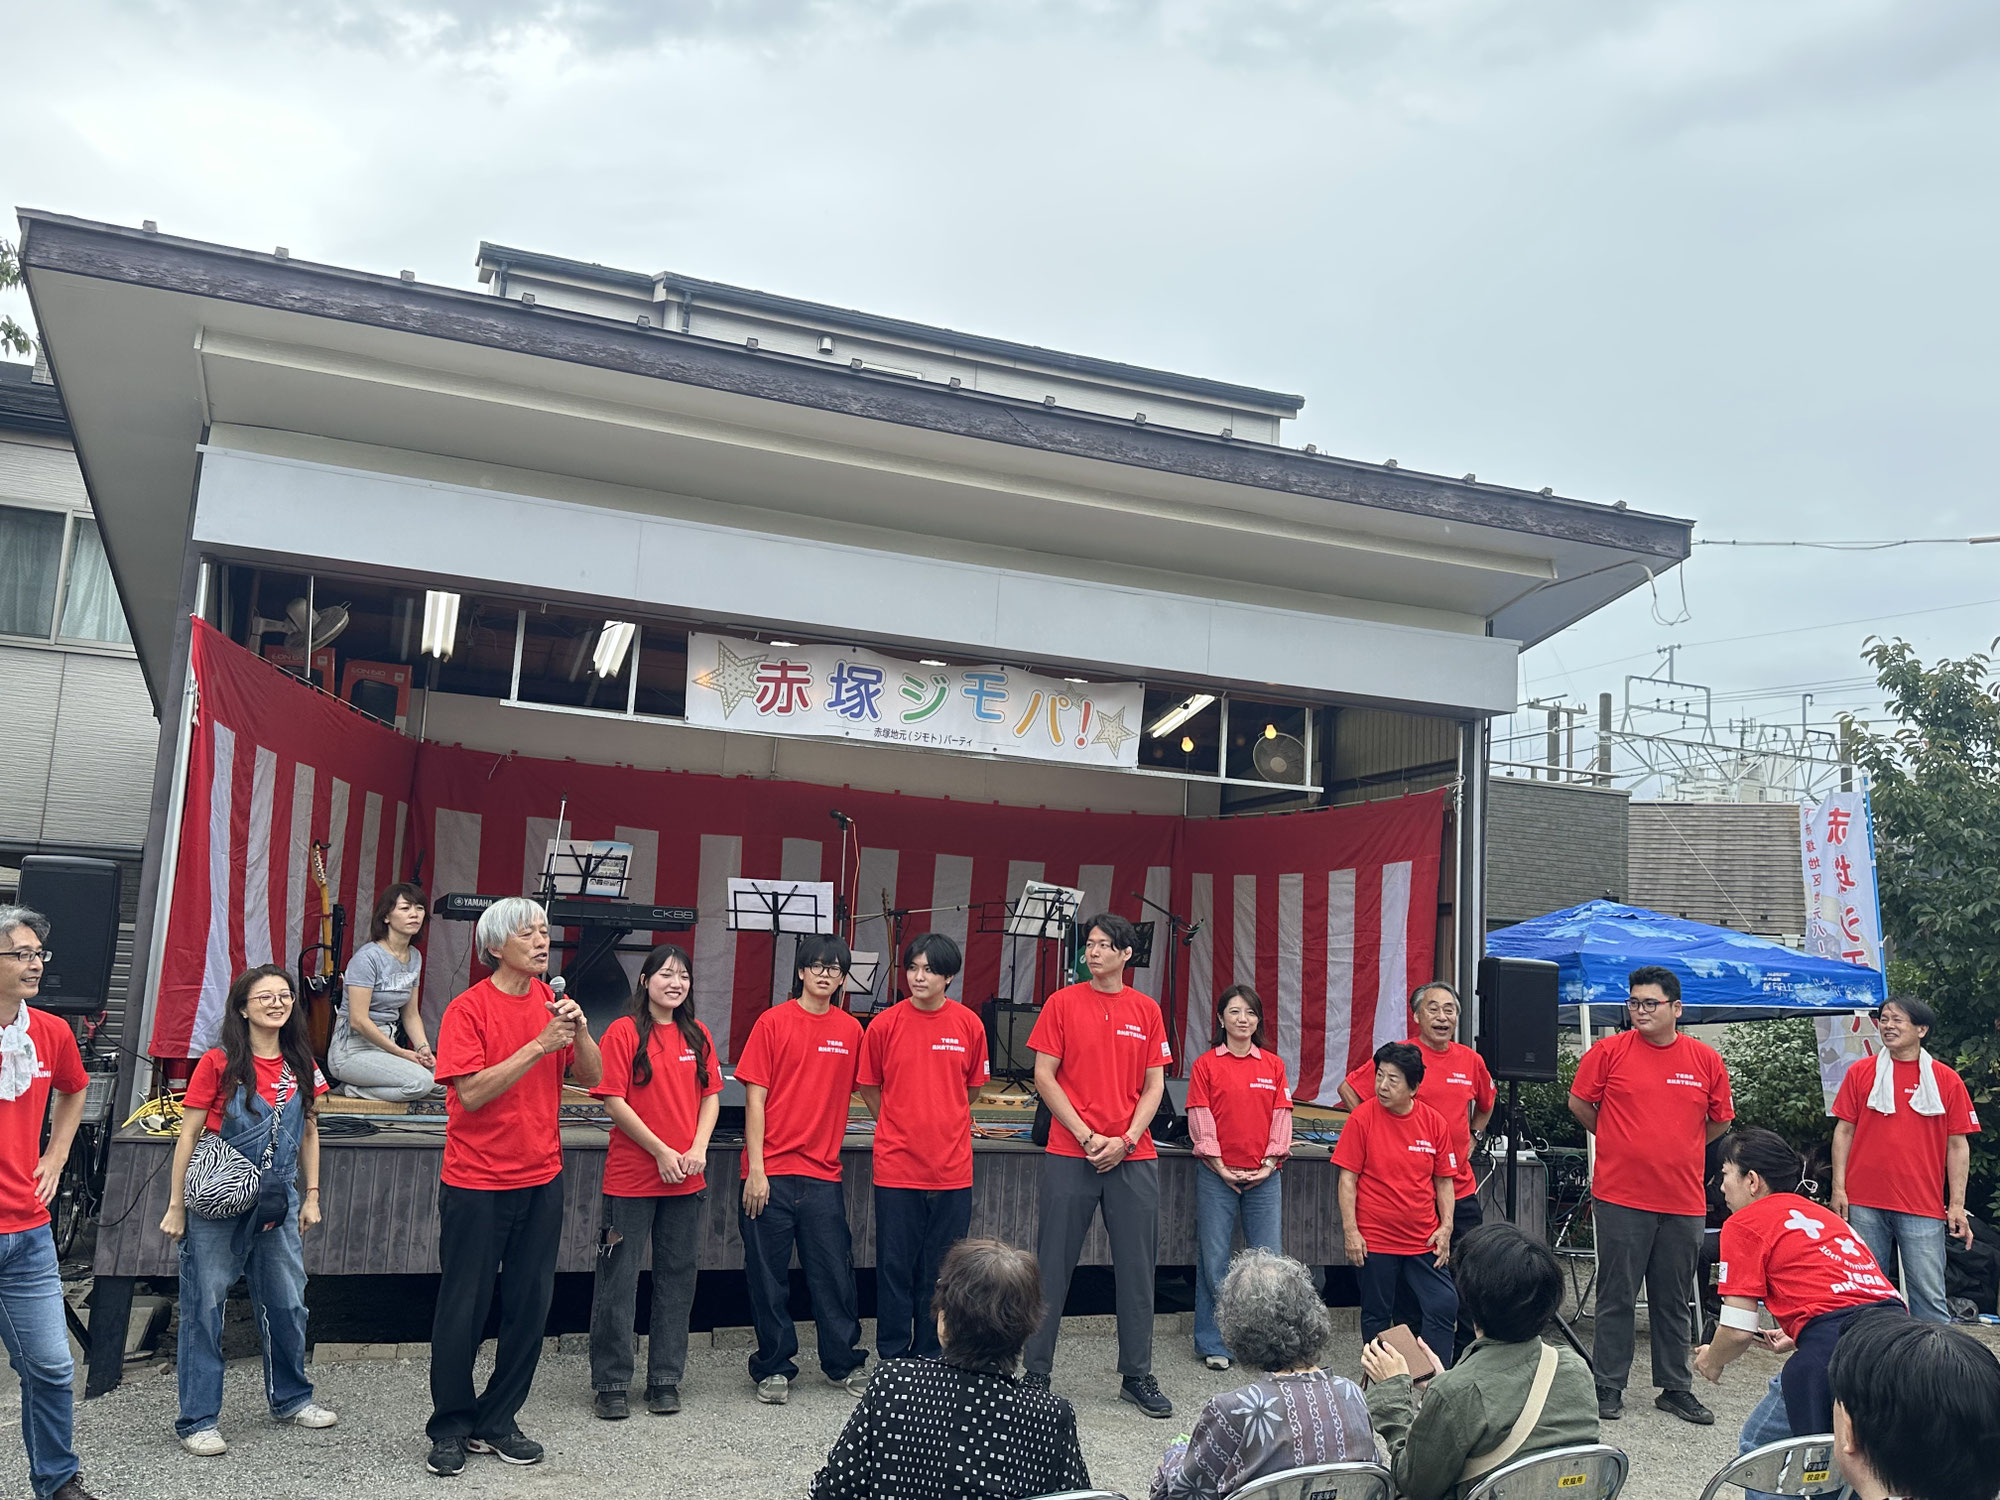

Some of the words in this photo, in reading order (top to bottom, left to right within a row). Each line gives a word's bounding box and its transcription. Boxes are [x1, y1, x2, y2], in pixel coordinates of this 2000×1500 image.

[755, 659, 1092, 748] 赤塚ジモパ!
[463, 897, 493, 907] YAMAHA
[652, 909, 694, 920] CK88
[1818, 1244, 1843, 1263] 10th
